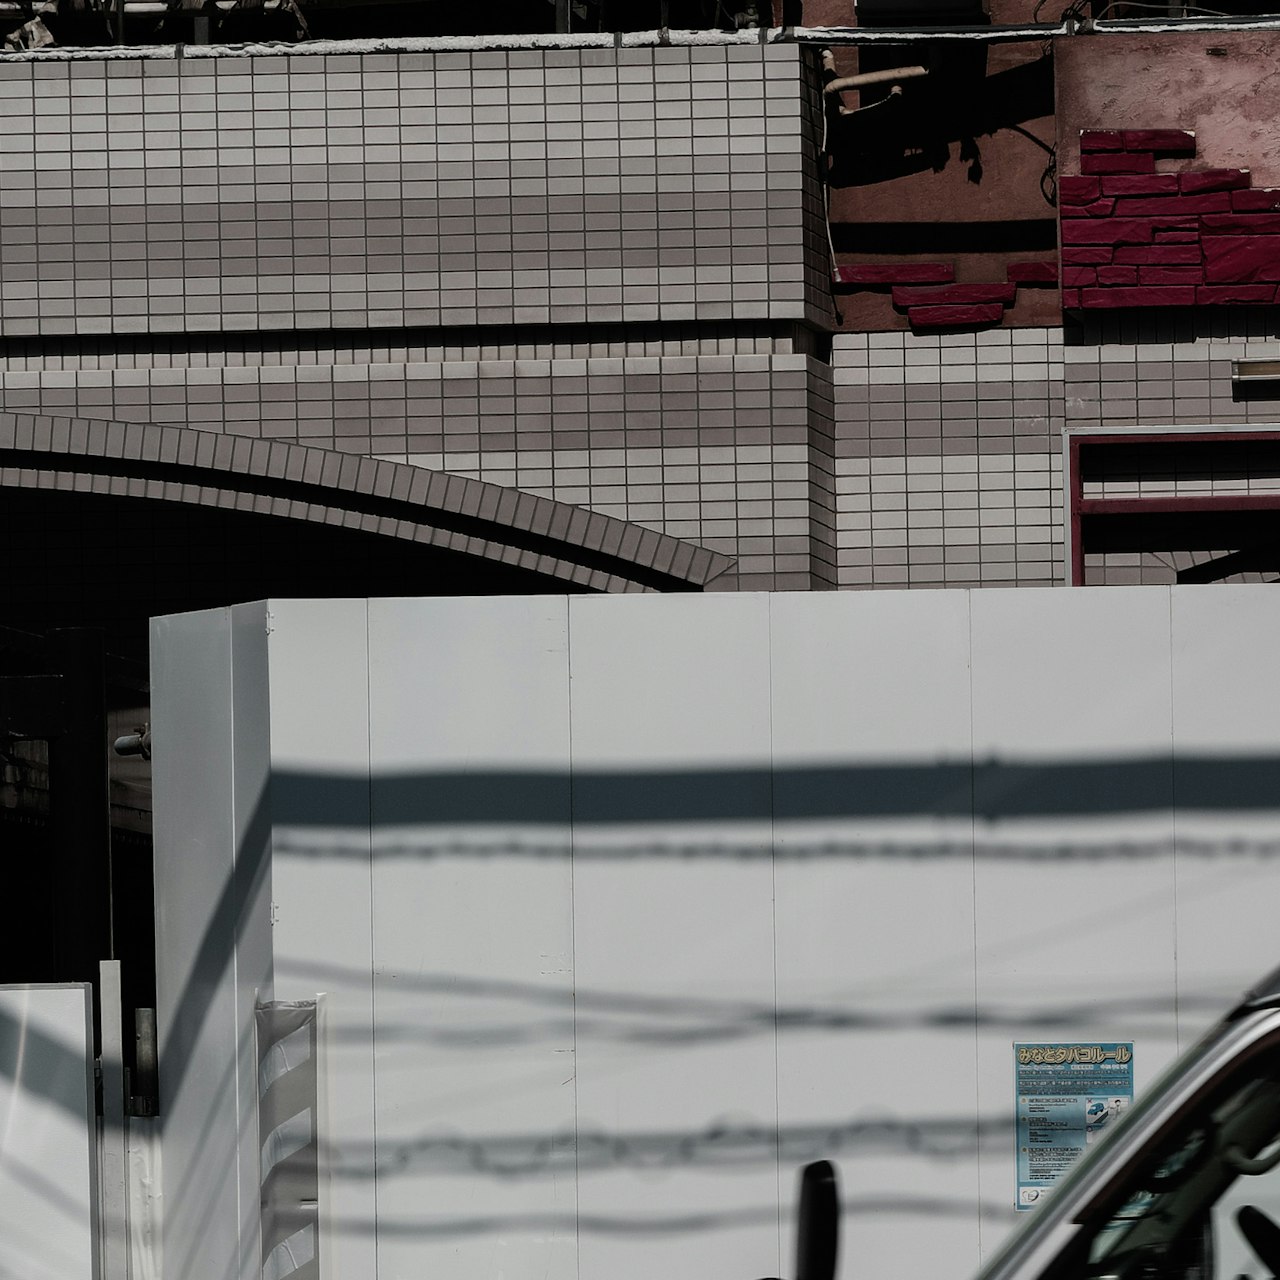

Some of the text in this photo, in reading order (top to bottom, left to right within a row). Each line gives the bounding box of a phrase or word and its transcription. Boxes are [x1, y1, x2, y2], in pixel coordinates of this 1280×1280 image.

[1018, 1047, 1131, 1064] みなとタバコルール
